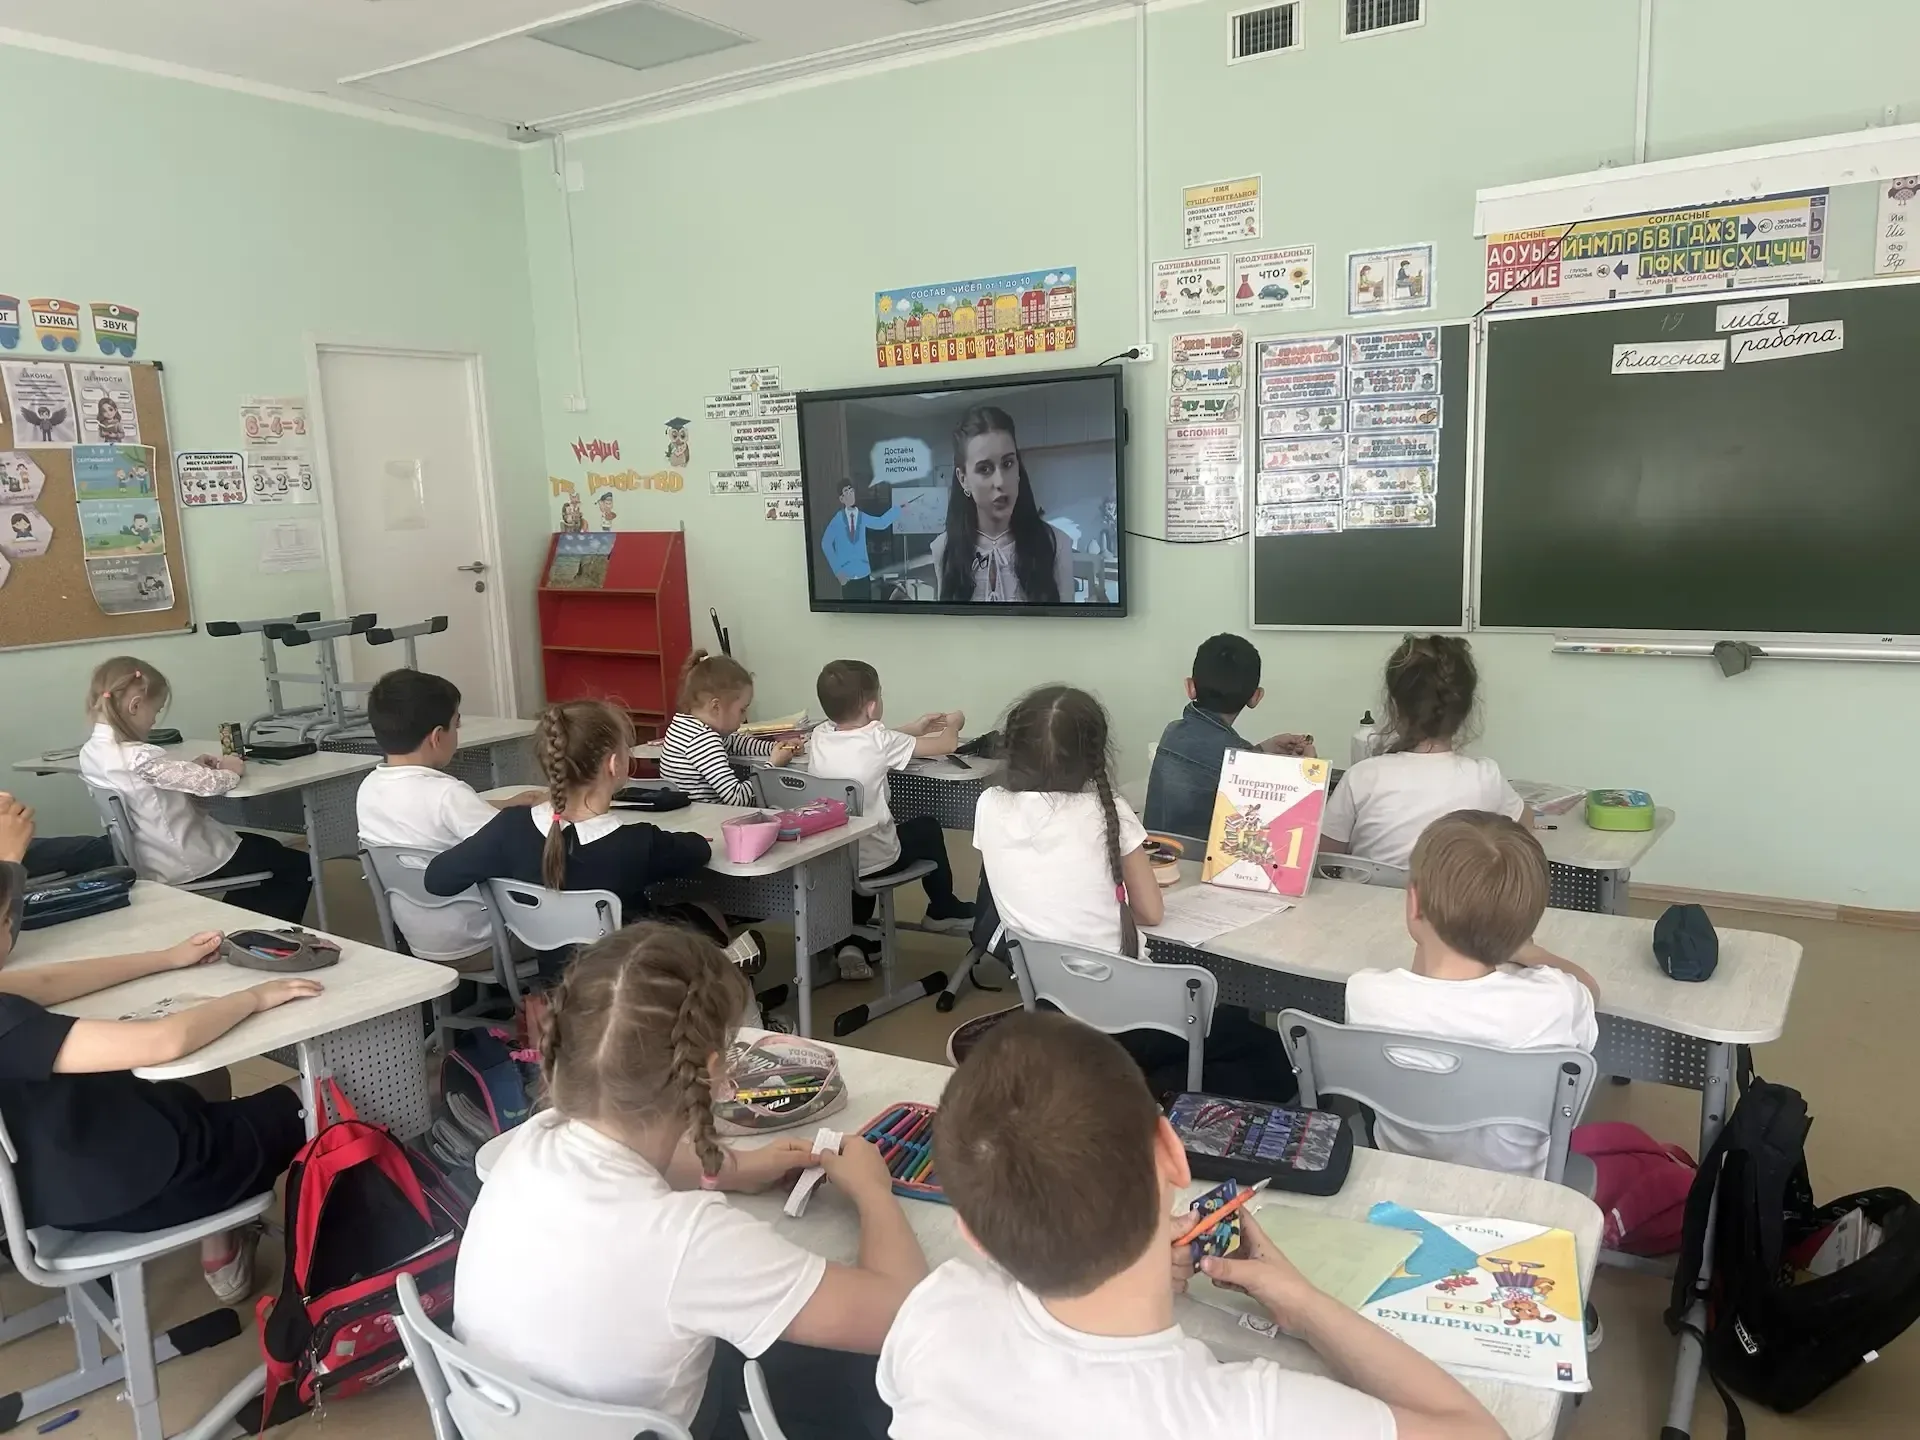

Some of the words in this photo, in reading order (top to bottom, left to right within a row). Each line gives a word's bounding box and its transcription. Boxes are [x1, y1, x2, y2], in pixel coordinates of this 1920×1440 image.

[1186, 190, 1256, 206] СУЩЕСТВИТЕЛЬНОЕ
[1648, 211, 1711, 224] СОГЛАСНЫЕ
[1503, 230, 1546, 241] ГЛАСНЫЕ
[1236, 249, 1312, 264] НЕОДУШЕВЛЕННЫЕ
[1159, 258, 1220, 270] ОДУШЕВЛЕННЫЕ
[1177, 274, 1202, 285] КТО?
[1259, 268, 1286, 279] ЧТО?
[1646, 277, 1679, 285] ПАРНЫЕ
[1682, 273, 1729, 282] СОГЛАСНЫЕ
[911, 288, 946, 299] СОСТАВ
[952, 281, 982, 294] ЧИСЕЛ
[999, 280, 1002, 288] 1
[1006, 279, 1017, 288] до
[1020, 277, 1030, 285] 10
[40, 315, 74, 326] БУКВА
[103, 320, 128, 331] ЗВУК
[879, 350, 885, 362] 0
[889, 350, 893, 361] 1
[896, 349, 902, 361] 2
[914, 347, 919, 359] 4
[922, 346, 928, 358] 5
[931, 345, 937, 357] 6
[949, 343, 955, 355] 8
[958, 343, 964, 354] 9
[966, 341, 974, 353] 10
[976, 341, 984, 353] 11
[986, 339, 994, 351] 12
[996, 338, 1004, 350] 13
[1005, 337, 1014, 349] 14
[1015, 335, 1024, 348] 15
[1025, 335, 1034, 347] 16
[1045, 333, 1055, 345] 18
[1056, 332, 1064, 344] 19
[1066, 330, 1075, 343] 20
[1615, 350, 1722, 368] Классная
[1177, 428, 1228, 437] ВСПОМНИ!
[884, 446, 913, 455] Достаём
[885, 456, 915, 464] двойные
[1228, 773, 1299, 793] Литературное
[1238, 787, 1286, 802] ЧТЕНИЕ
[1280, 827, 1304, 869] 1
[1466, 1226, 1505, 1239] Часть
[1474, 1306, 1484, 1314] 8
[1375, 1308, 1563, 1347] Математика
